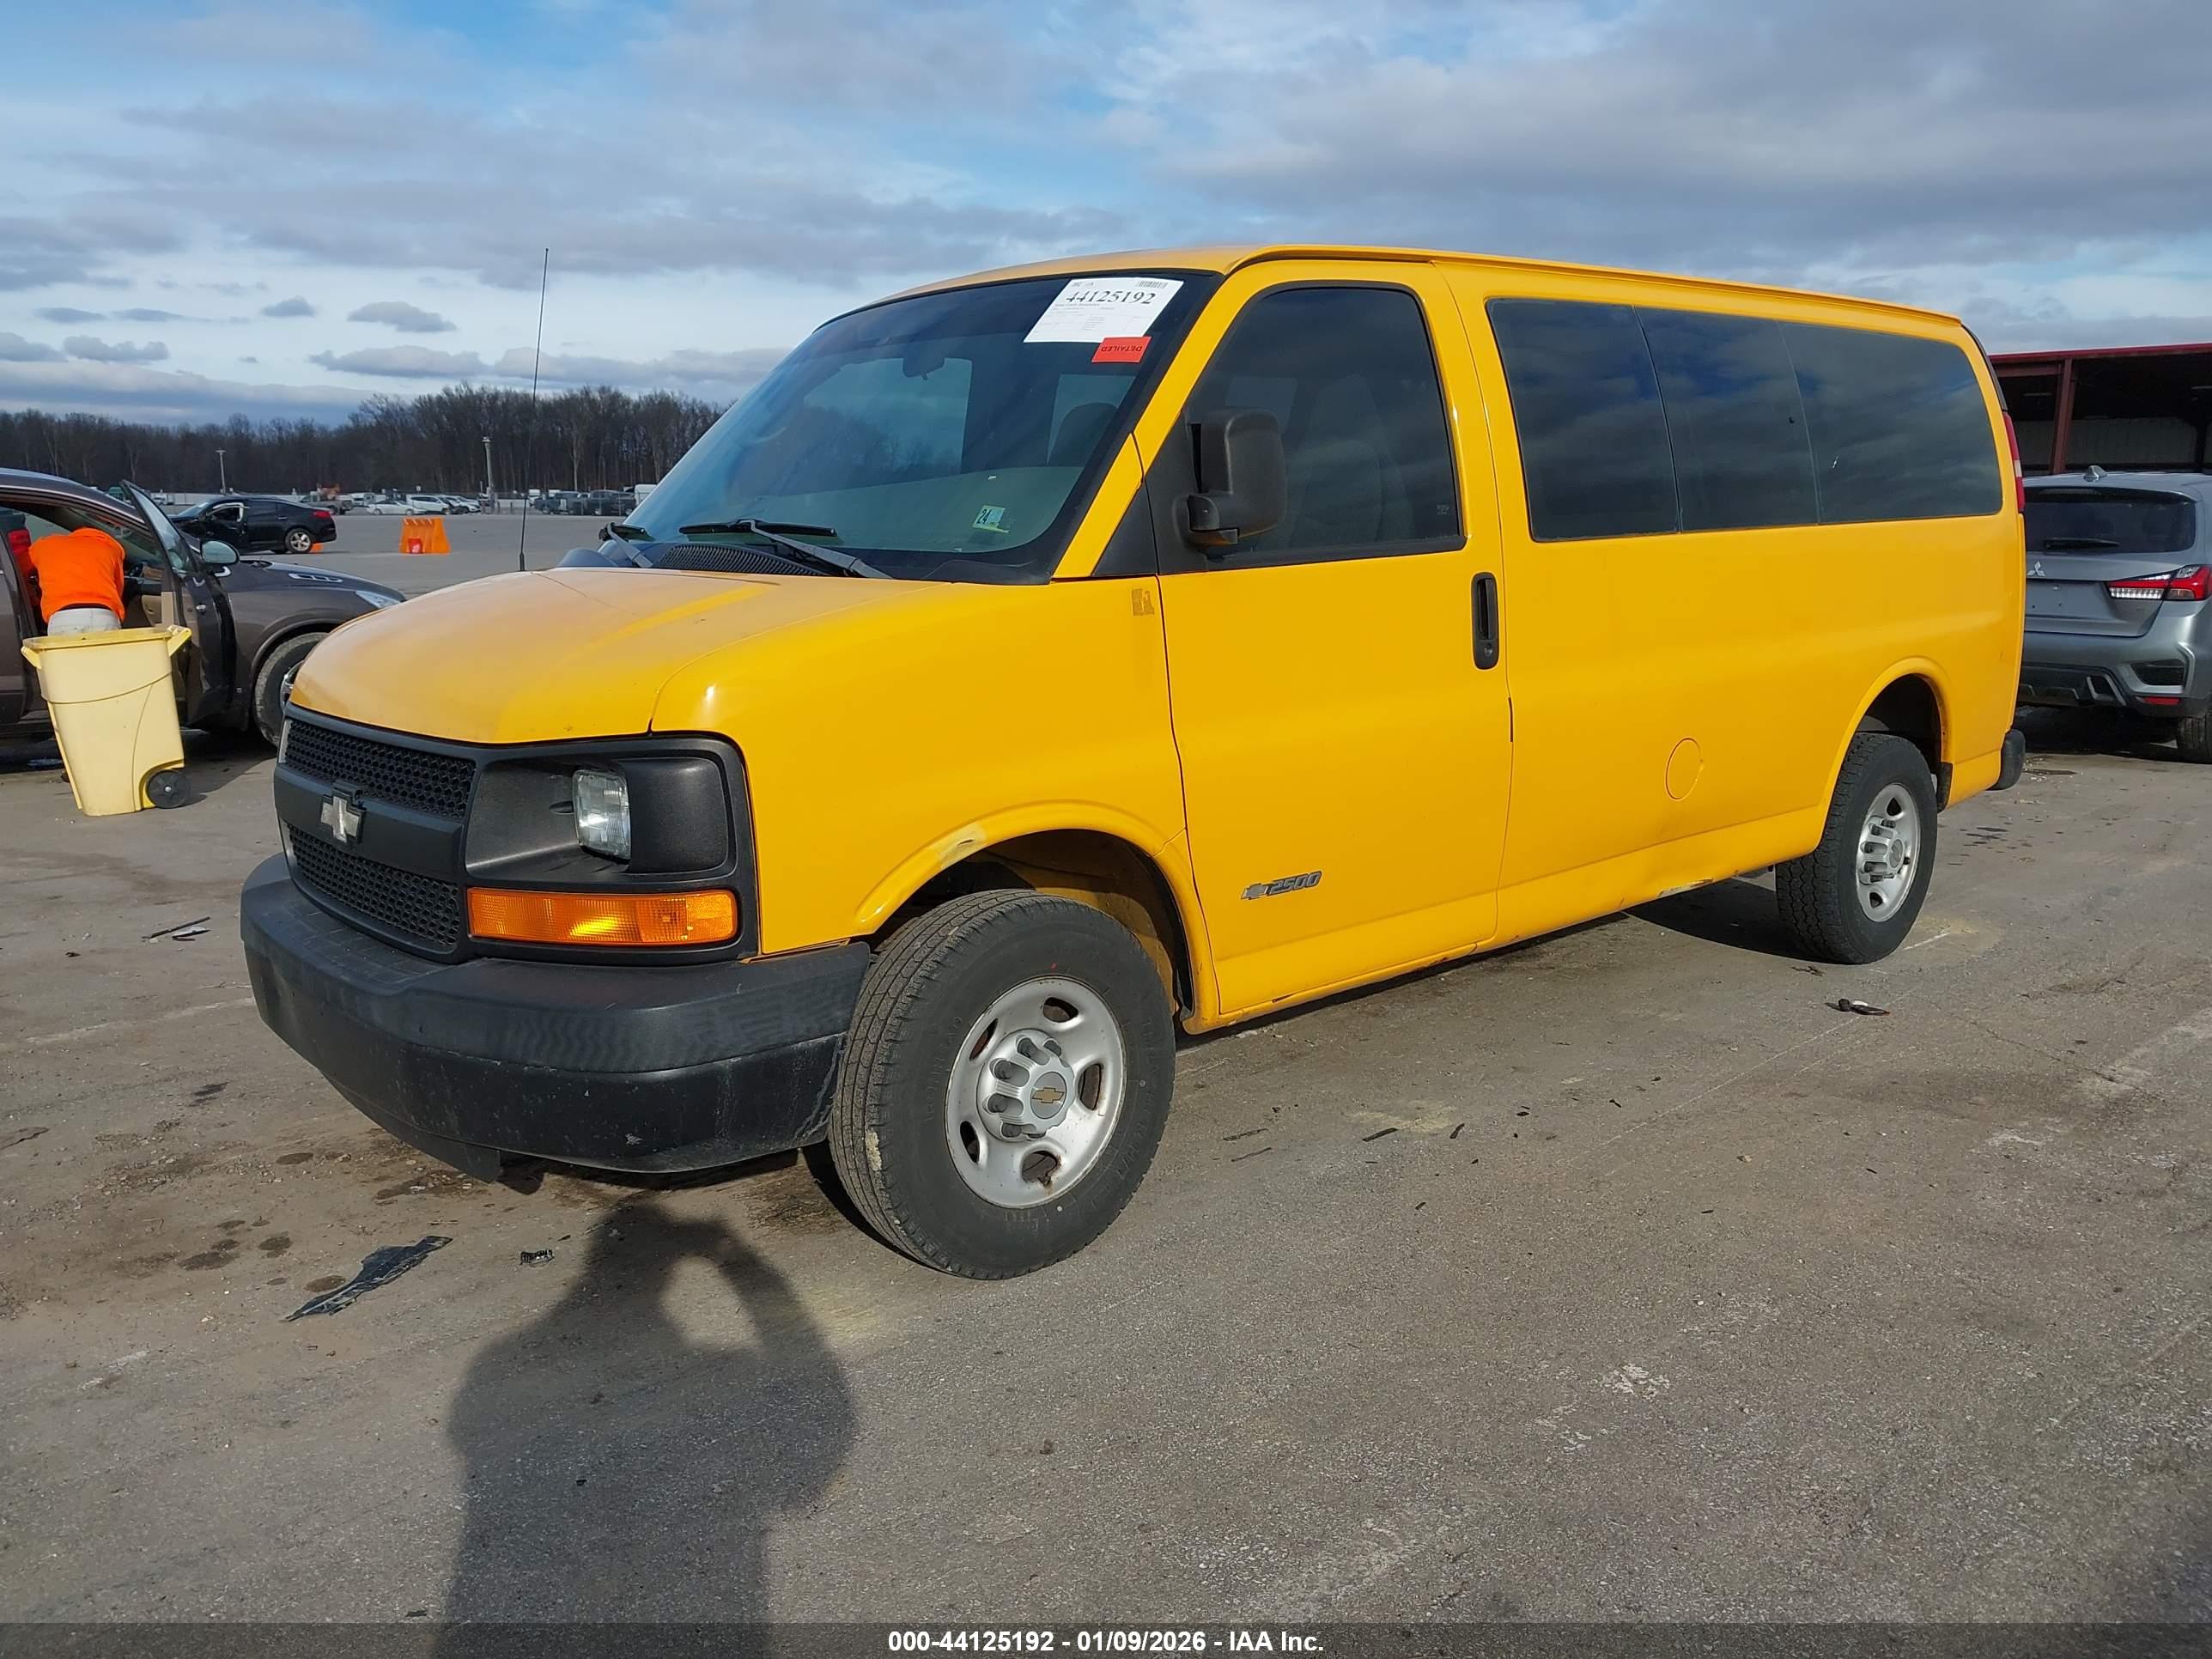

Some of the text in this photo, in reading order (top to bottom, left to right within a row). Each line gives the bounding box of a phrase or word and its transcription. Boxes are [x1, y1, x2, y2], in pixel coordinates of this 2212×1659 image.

[1066, 290, 1156, 304] 44125192
[976, 508, 992, 524] 24
[1268, 871, 1322, 896] 2500
